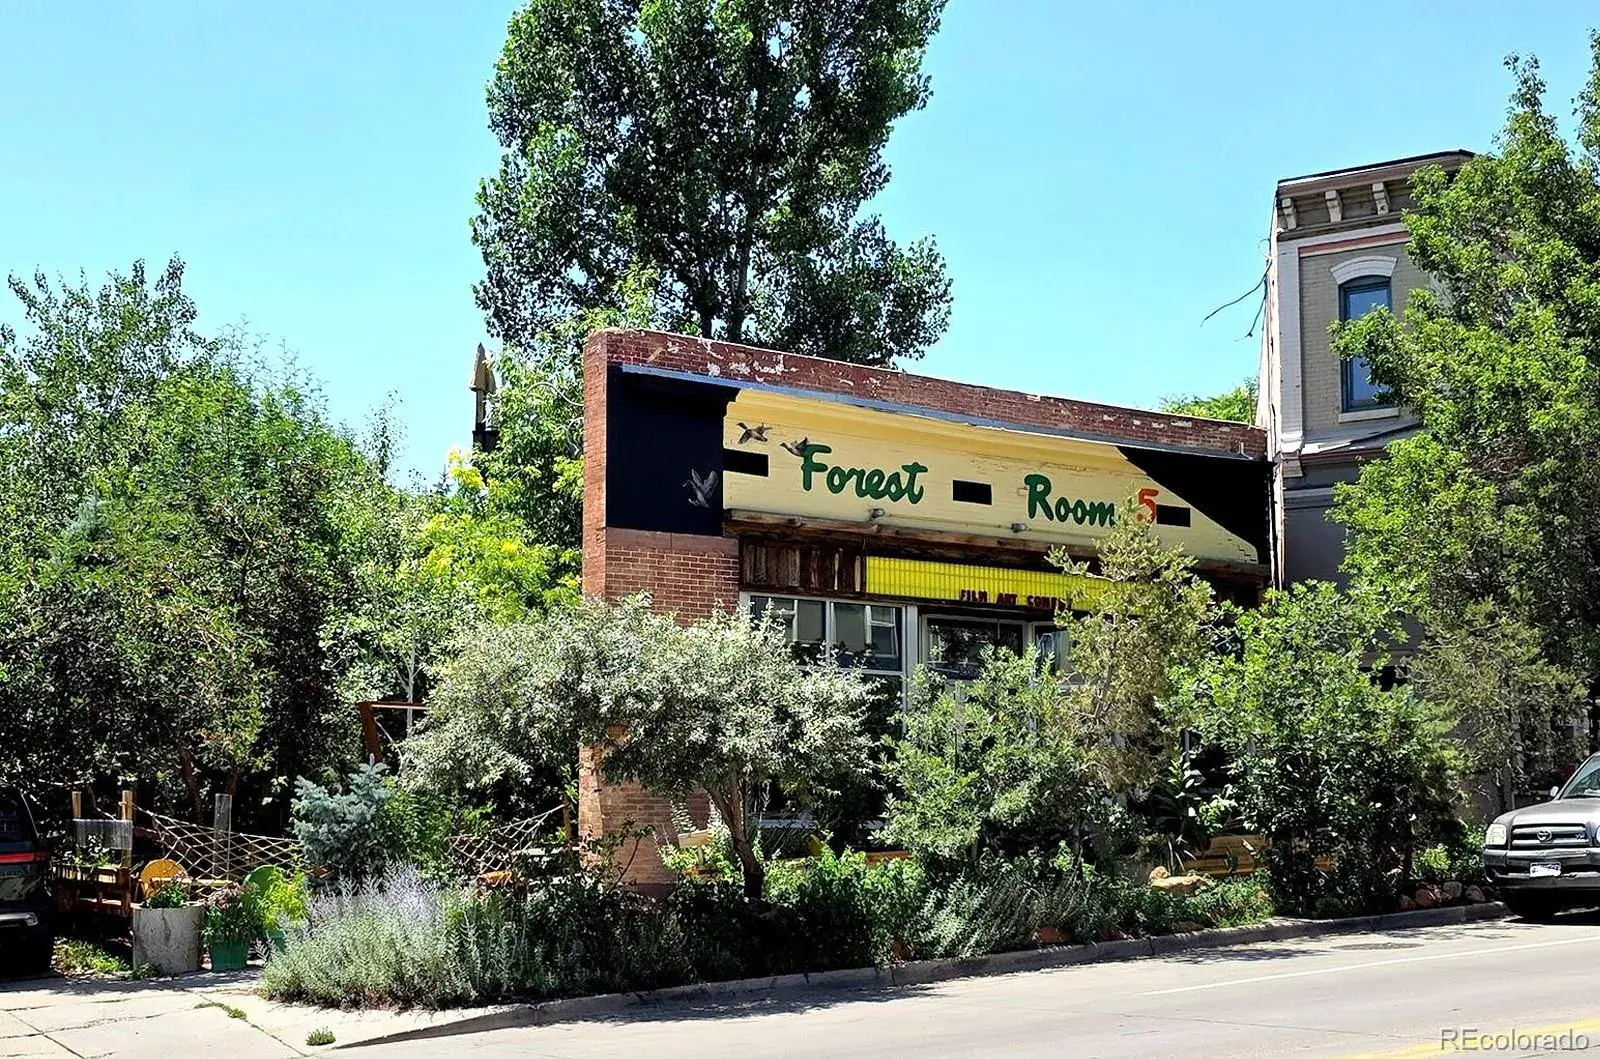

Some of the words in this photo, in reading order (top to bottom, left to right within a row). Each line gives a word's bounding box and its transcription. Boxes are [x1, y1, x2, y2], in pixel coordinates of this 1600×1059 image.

[801, 443, 928, 504] Forest
[1024, 473, 1116, 528] Room
[1132, 488, 1159, 525] 5
[960, 589, 988, 604] FILM
[996, 592, 1018, 606] ART
